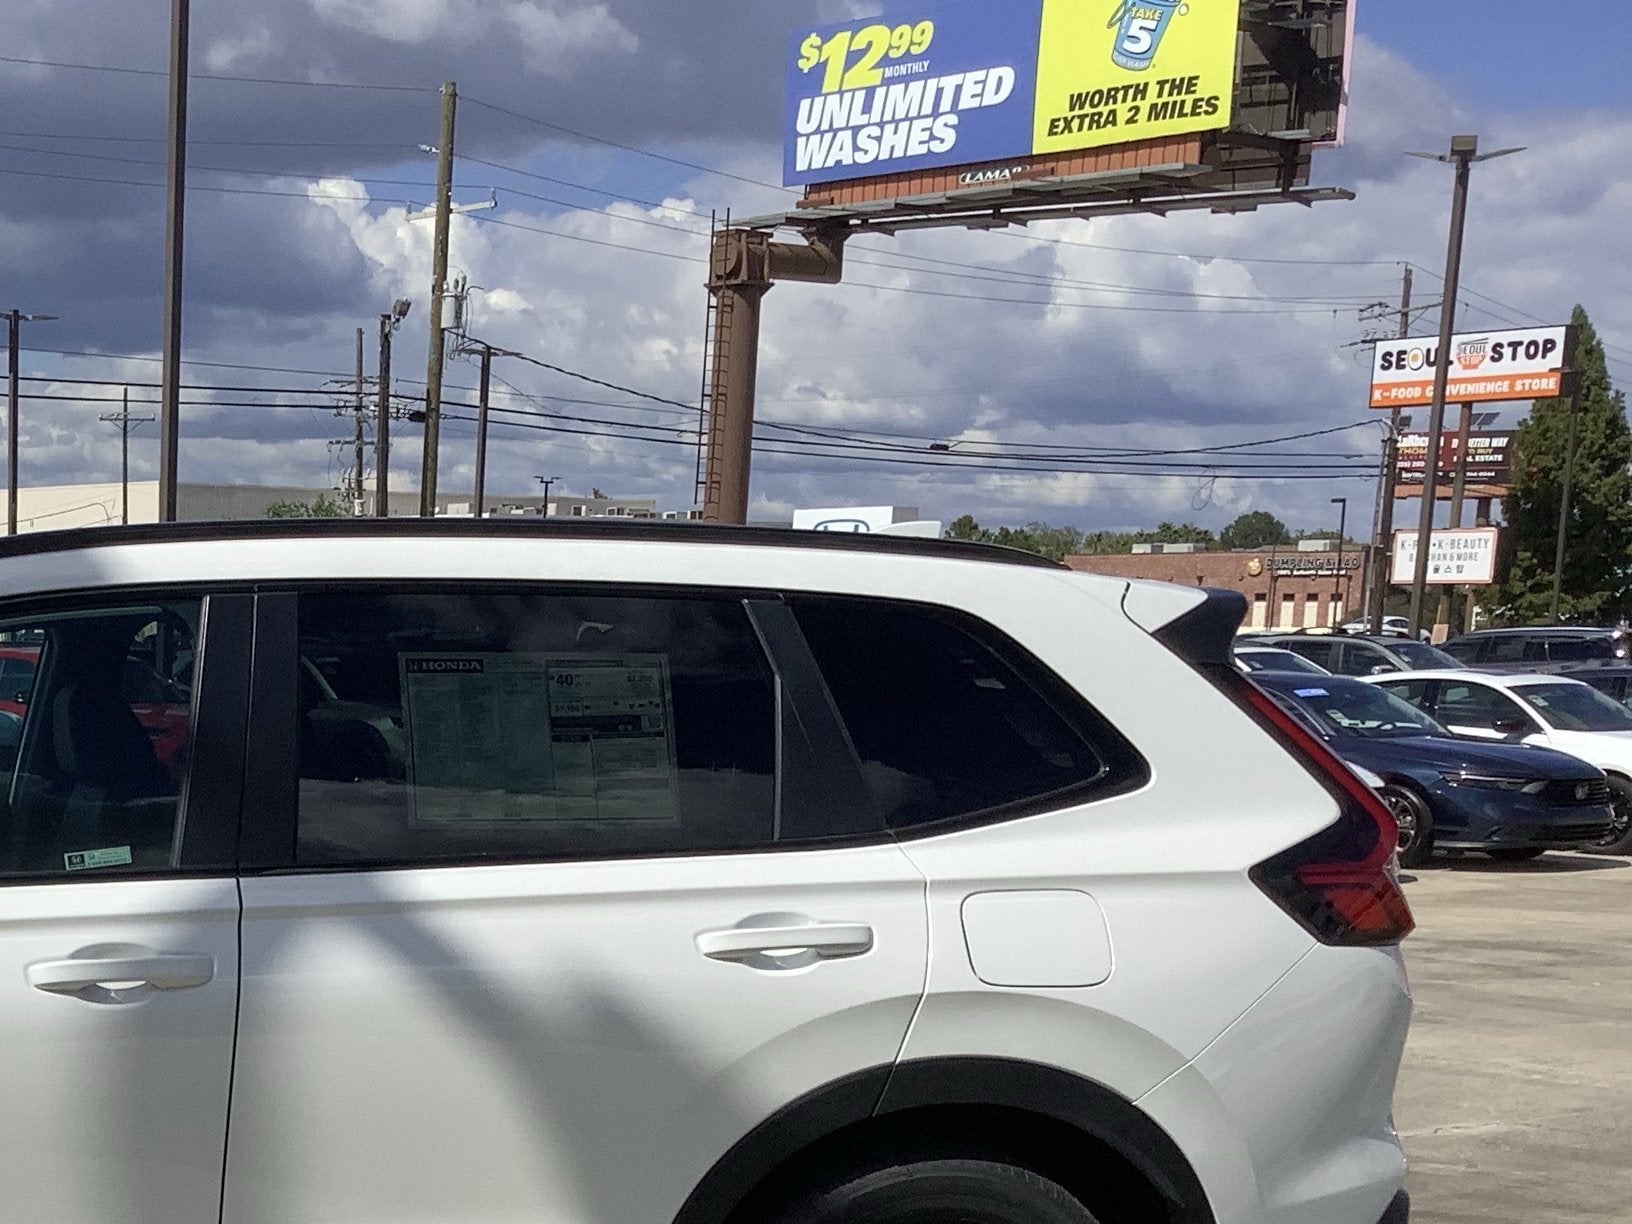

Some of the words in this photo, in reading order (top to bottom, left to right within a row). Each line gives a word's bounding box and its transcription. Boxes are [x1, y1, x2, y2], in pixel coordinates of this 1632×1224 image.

[1132, 7, 1163, 20] TAKE
[1122, 18, 1158, 54] 5
[884, 60, 930, 79] MONTHLY
[796, 66, 1015, 135] UNLIMITED
[1069, 82, 1149, 112] WORTH
[1156, 75, 1200, 98] THE
[1047, 110, 1118, 137] EXTRA
[1125, 105, 1141, 125] 2
[1147, 96, 1220, 122] MILES
[795, 114, 959, 172] WASHES
[1380, 347, 1454, 371] SEOU
[1490, 338, 1557, 363] STOP
[1374, 386, 1422, 401] K-FOOD
[1425, 380, 1510, 398] CVENIENCE
[1514, 377, 1557, 392] STORE
[1438, 538, 1489, 550] K-BEAUTY
[1266, 556, 1323, 569] DUMPLING
[423, 661, 482, 671] HONDA
[556, 674, 573, 688] 40
